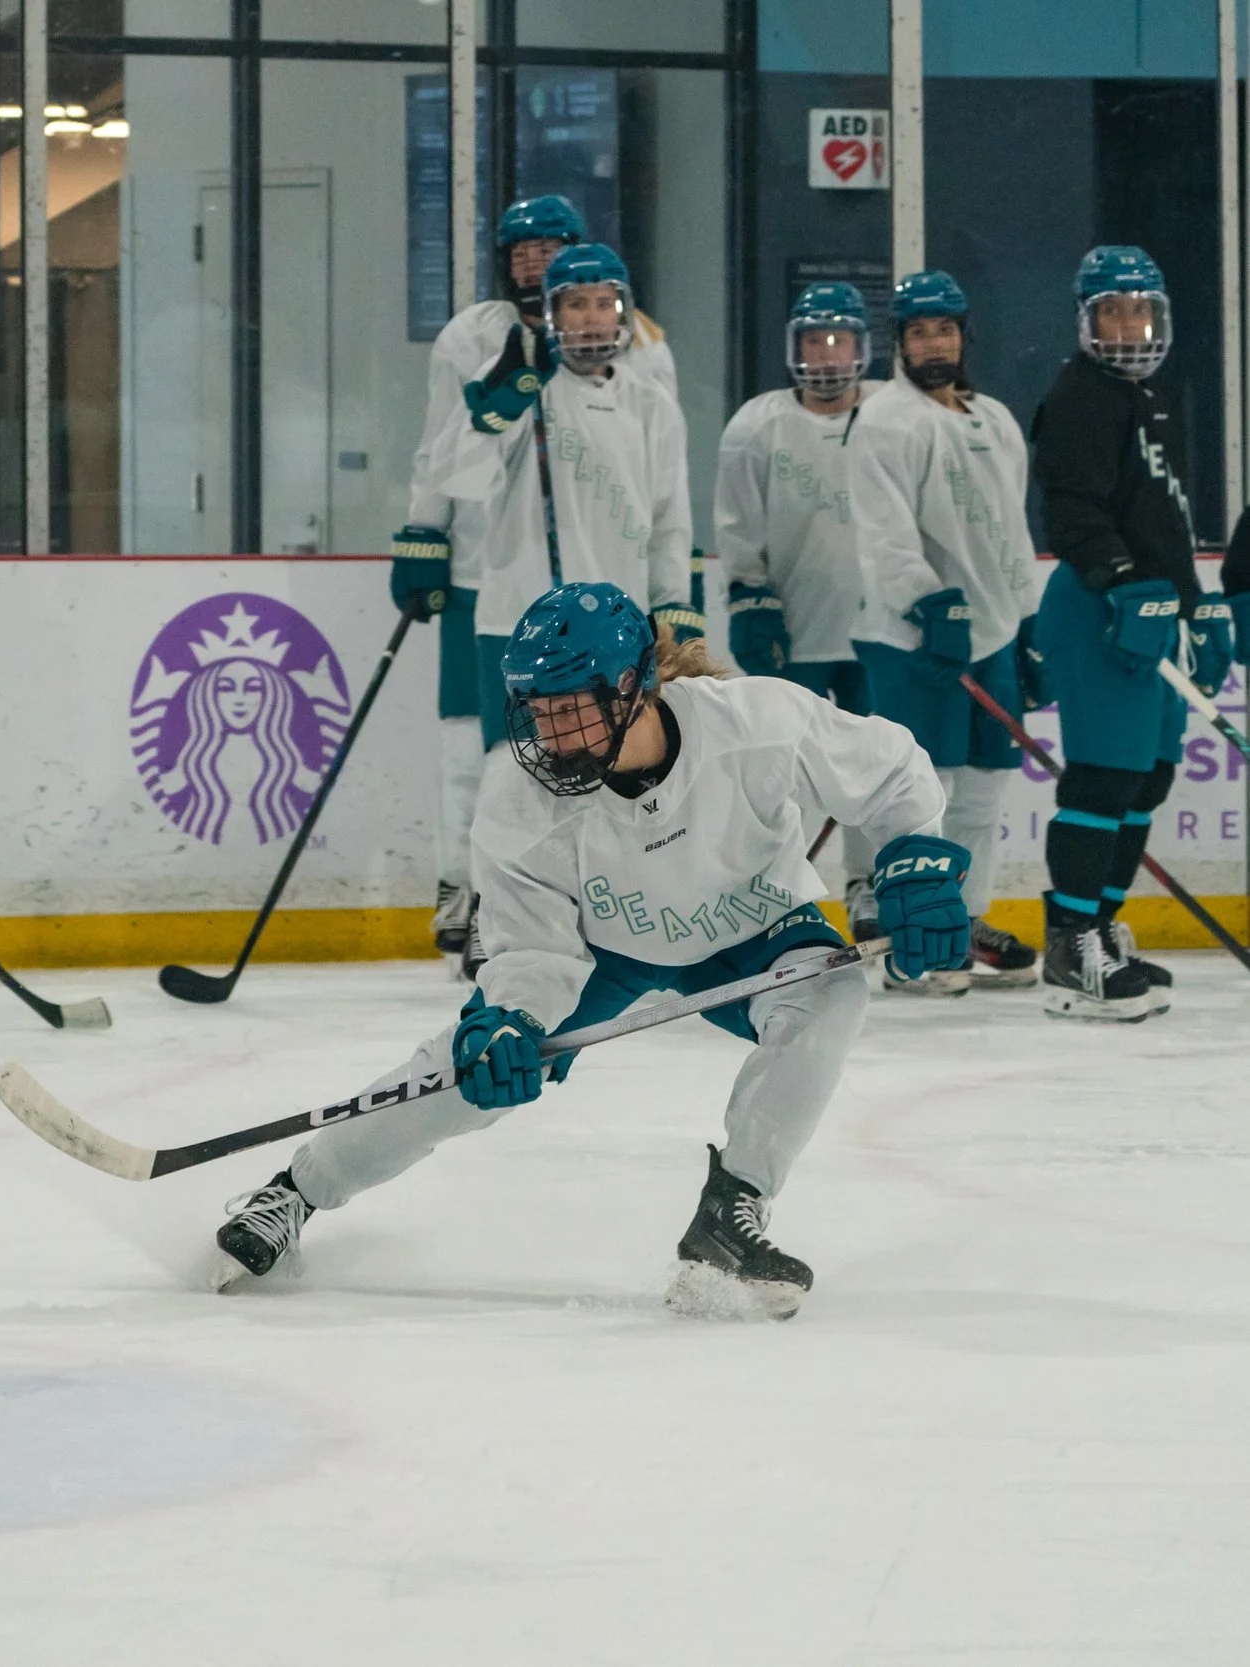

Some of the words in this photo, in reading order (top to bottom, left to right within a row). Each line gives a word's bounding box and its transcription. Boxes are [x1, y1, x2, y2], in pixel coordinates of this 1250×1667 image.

[822, 116, 867, 136] AED
[644, 827, 687, 853] BAUER
[584, 874, 793, 943] SEATTLE
[309, 1067, 455, 1128] CCM
